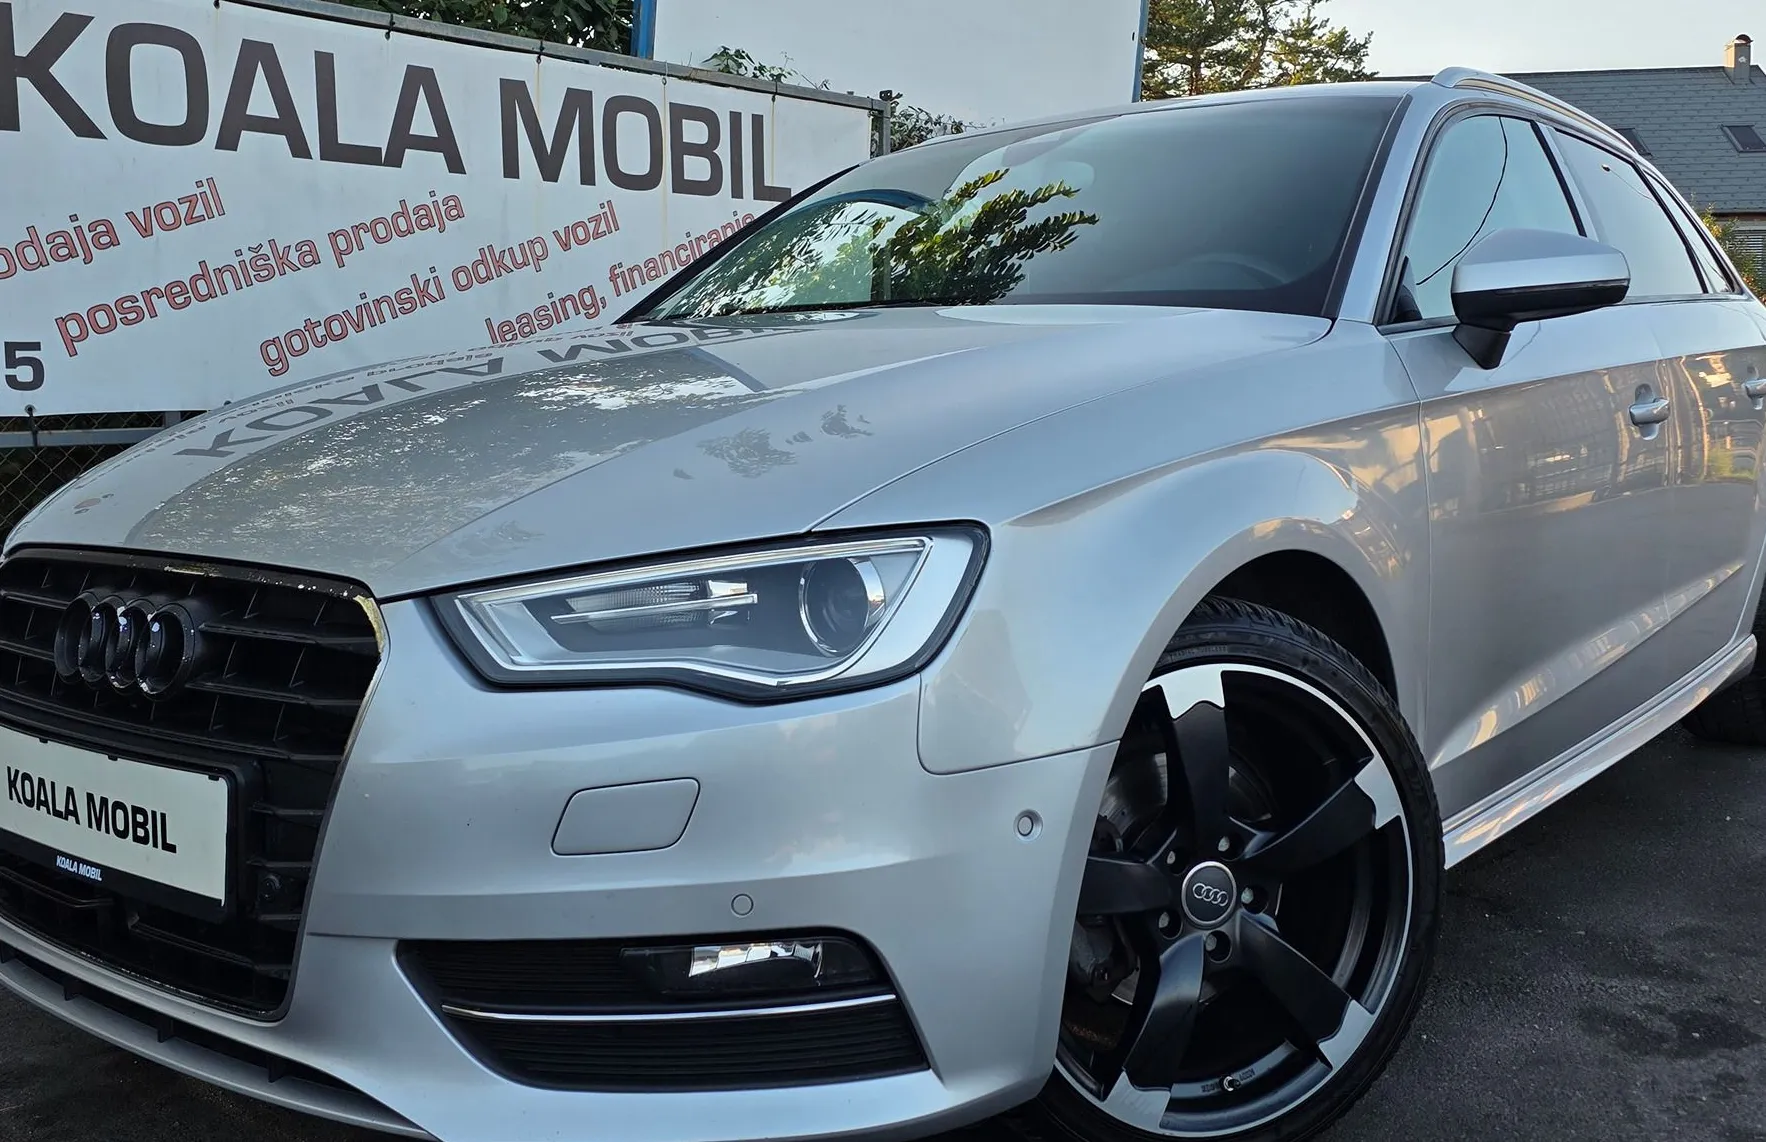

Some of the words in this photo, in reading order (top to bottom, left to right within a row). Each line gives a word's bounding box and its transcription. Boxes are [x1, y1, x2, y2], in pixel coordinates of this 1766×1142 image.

[0, 2, 467, 174] KOALA
[499, 78, 792, 201] MOBIL
[125, 177, 226, 238] vozil
[55, 239, 321, 357] posredniška
[327, 190, 465, 268] prodaja
[259, 266, 446, 377] gotovinski
[451, 235, 549, 292] odkup
[553, 200, 620, 253] vozil
[485, 284, 607, 345] leasing,
[4, 341, 45, 391] 5
[7, 766, 80, 825] KOALA
[86, 792, 177, 854] MOBIL
[57, 855, 78, 873] KOALA
[79, 863, 102, 881] MOBIL
